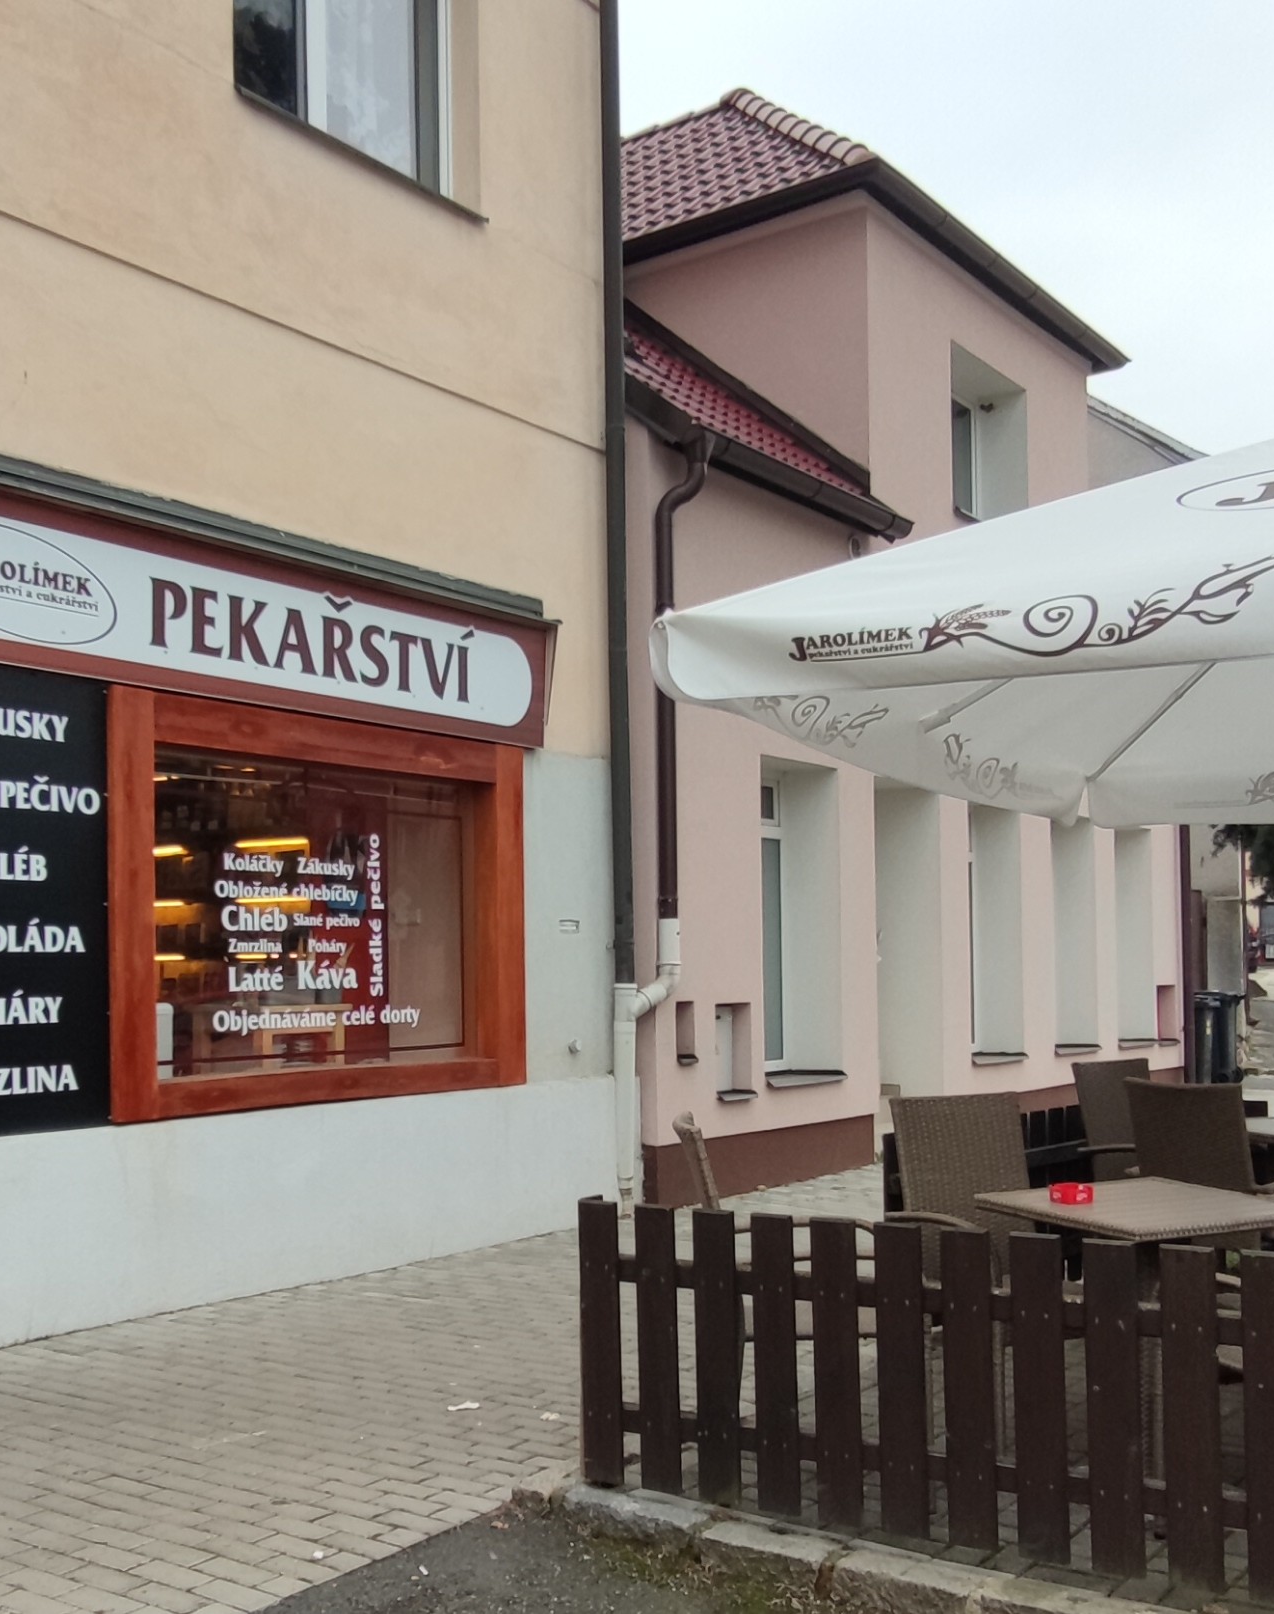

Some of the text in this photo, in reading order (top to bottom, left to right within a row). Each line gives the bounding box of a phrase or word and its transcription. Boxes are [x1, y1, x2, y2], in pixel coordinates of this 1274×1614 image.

[26, 590, 33, 599] a
[148, 575, 475, 704] PEKAŘSTVÍ
[788, 626, 913, 662] JAROLÍMEK
[222, 852, 356, 880] Koláčky Zákusky
[214, 880, 359, 906] Obložené chlebíčky
[221, 905, 361, 932] Chléb Slané pečivo
[366, 833, 385, 997] Sladké pečivo
[228, 938, 347, 956] Zmrzlina Poháry
[228, 959, 358, 993] Latté Káva
[212, 1004, 421, 1037] Objednáváme celé dorty
